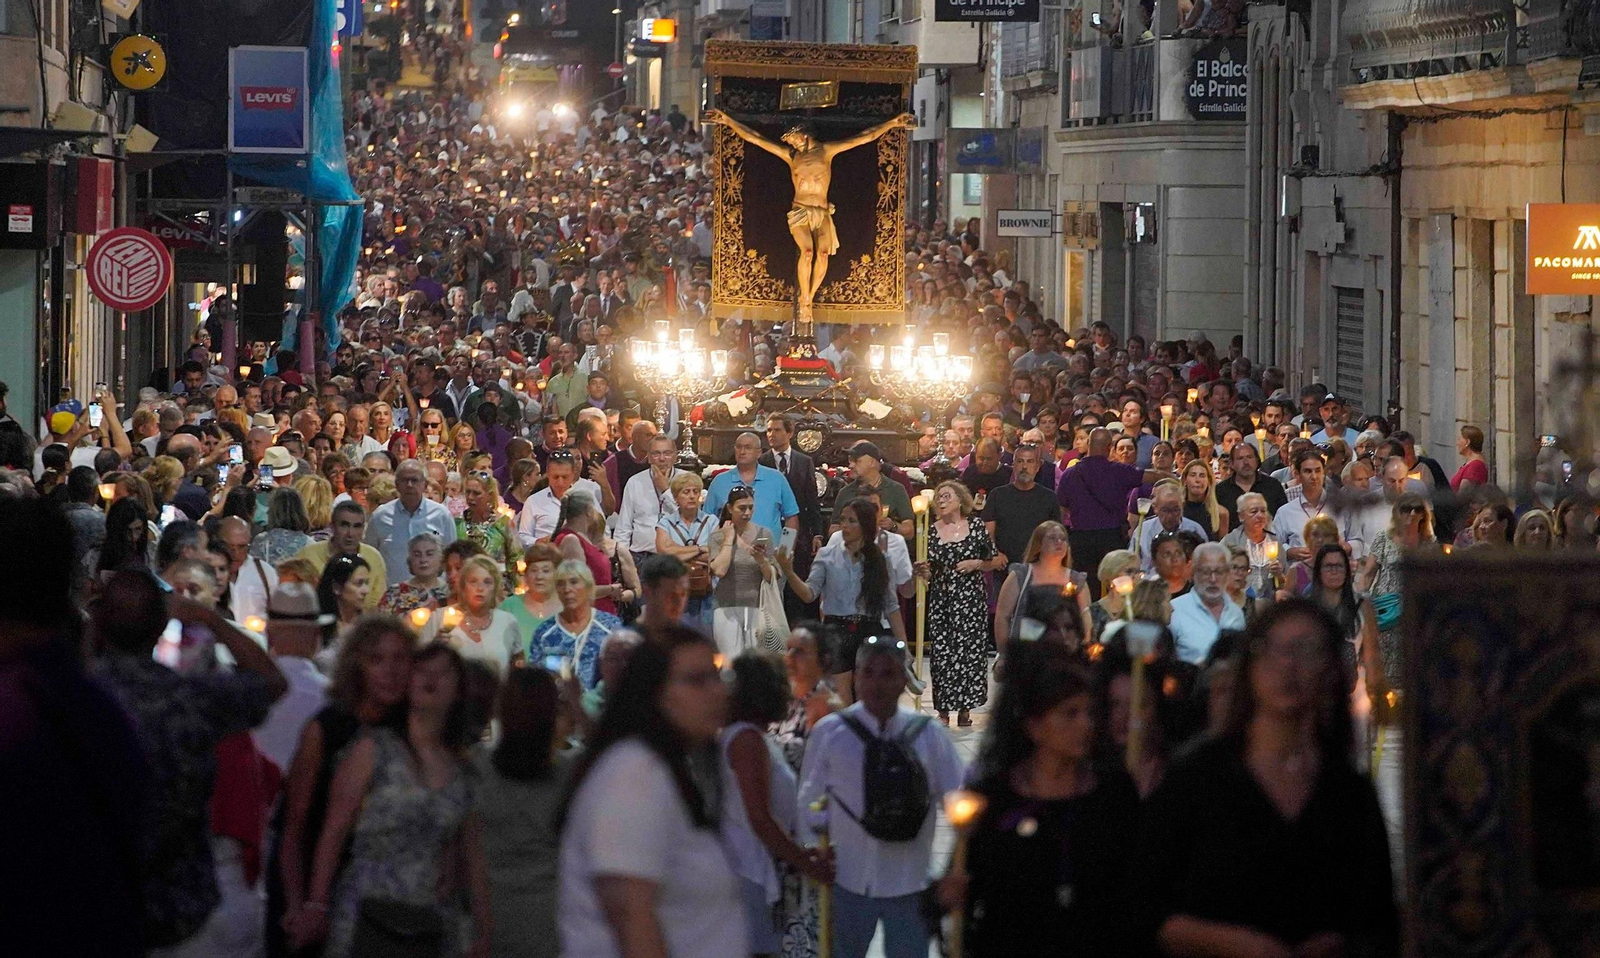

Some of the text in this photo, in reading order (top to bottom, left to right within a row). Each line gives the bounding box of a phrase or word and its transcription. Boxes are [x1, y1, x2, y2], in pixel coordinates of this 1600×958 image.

[1197, 60, 1207, 77] El
[1190, 80, 1204, 97] de
[1199, 103, 1222, 112] Estrella
[999, 219, 1050, 227] BROWNIE
[100, 254, 129, 298] REI
